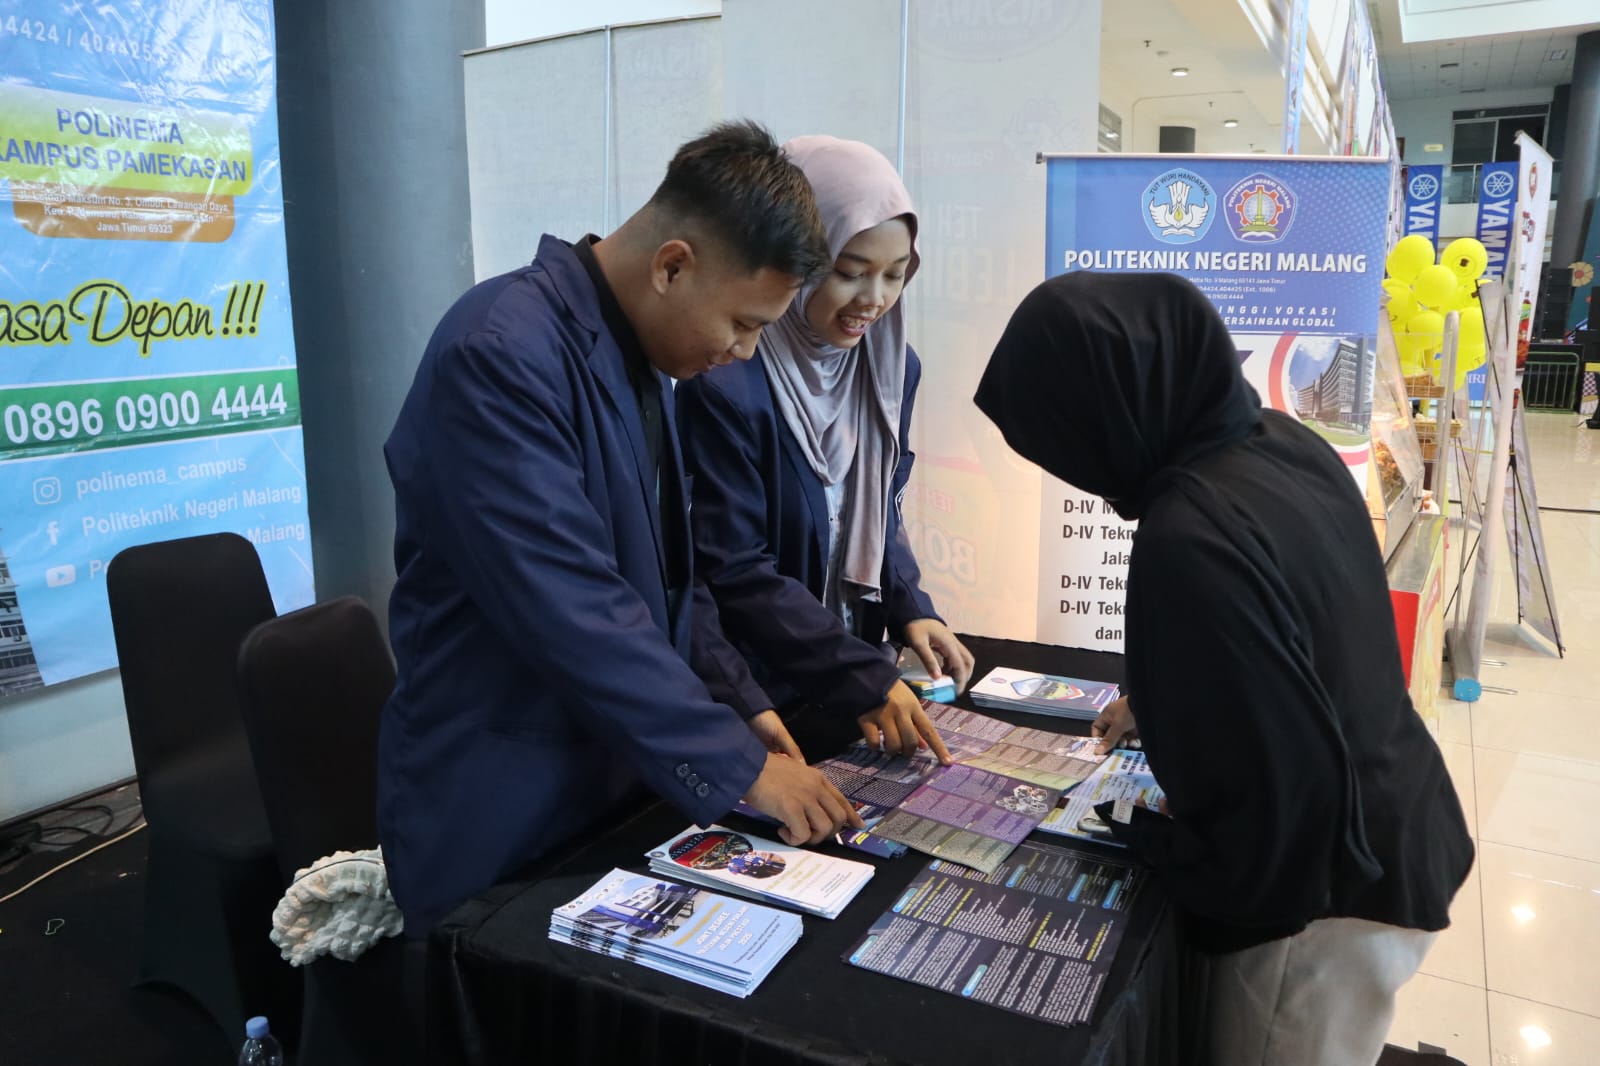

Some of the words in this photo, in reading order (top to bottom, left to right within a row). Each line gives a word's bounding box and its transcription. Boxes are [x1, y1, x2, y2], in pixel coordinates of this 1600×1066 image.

[0, 14, 59, 44] 4424
[56, 108, 184, 145] POLINEMA
[0, 139, 100, 171] AMPUS
[106, 149, 246, 182] PAMEKASAN
[1149, 182, 1160, 194] TUT
[1160, 173, 1177, 184] WURI
[1064, 250, 1190, 271] POLITEKNIK
[1195, 251, 1271, 272] NEGERI
[1276, 253, 1367, 274] MALANG
[69, 282, 213, 354] Depan
[1275, 306, 1336, 316] VOKASI
[1292, 317, 1336, 327] GLOBAL
[4, 398, 104, 444] 0896
[115, 390, 200, 432] 0900
[211, 382, 288, 421] 4444
[82, 504, 179, 536] Politeknik
[185, 492, 238, 519] Negeri
[243, 486, 302, 507] Malang
[1063, 499, 1095, 514] D-IV
[248, 523, 305, 545] Malang
[1062, 524, 1094, 539] D-IV
[1061, 574, 1092, 589] D-IV
[1060, 600, 1091, 614] D-IV
[1095, 626, 1122, 640] dan
